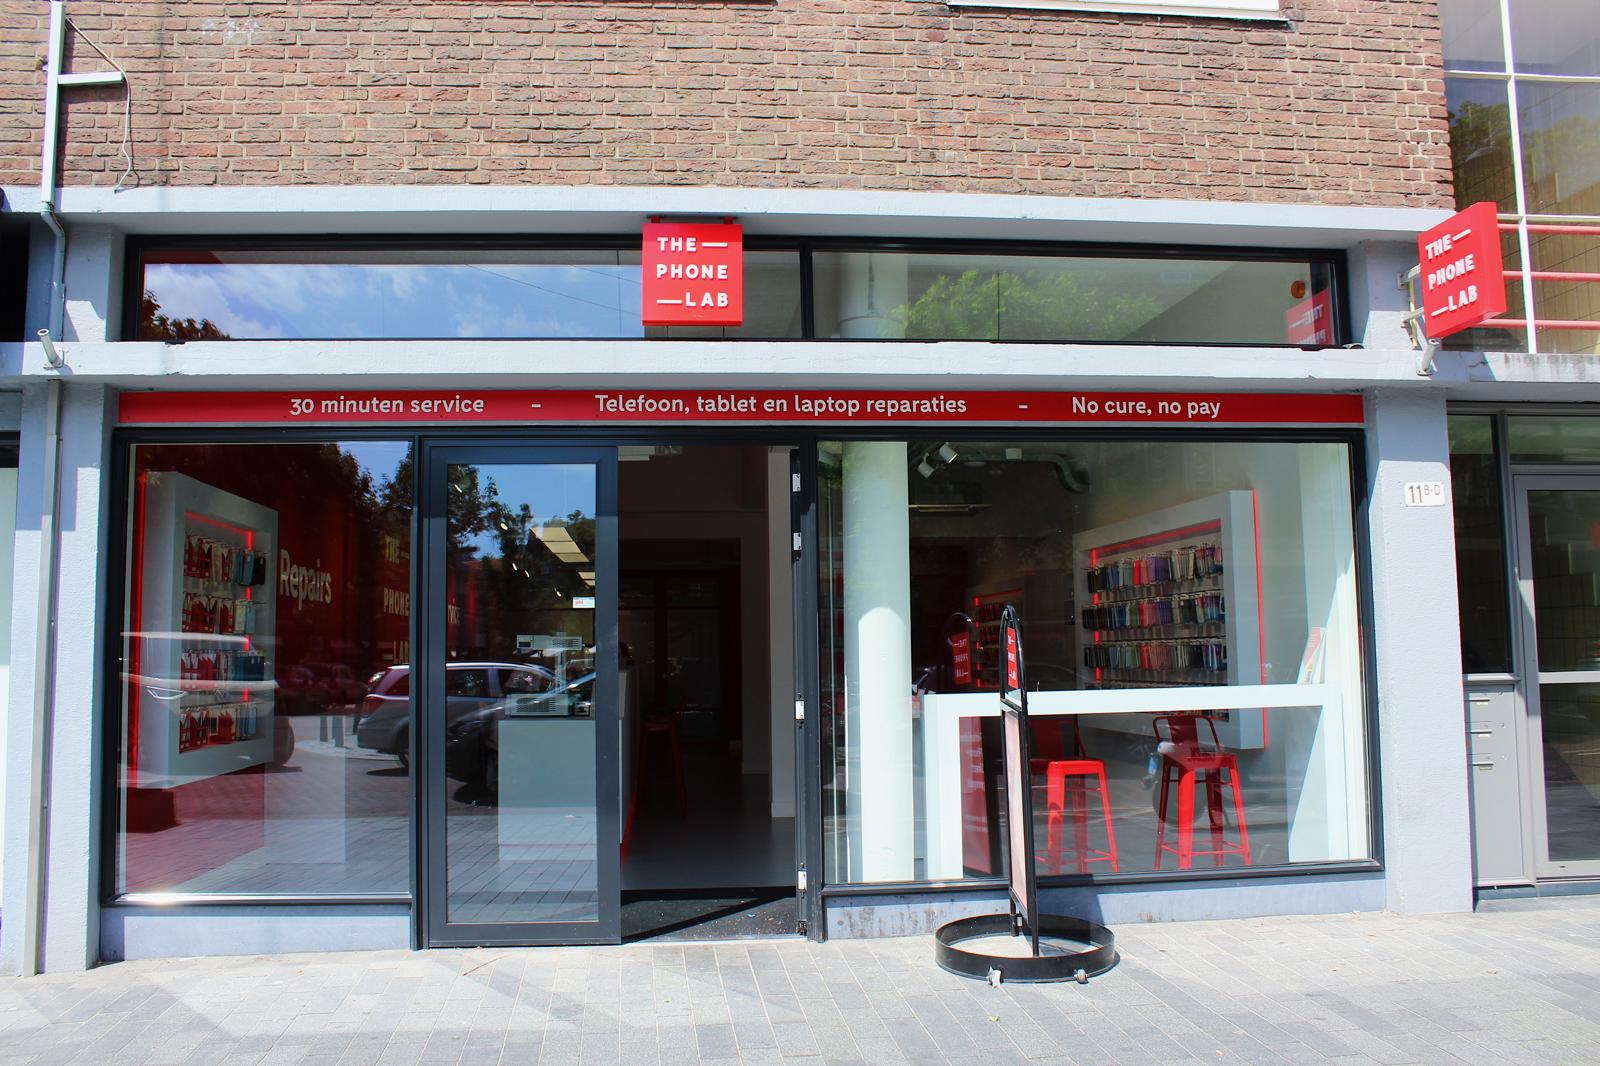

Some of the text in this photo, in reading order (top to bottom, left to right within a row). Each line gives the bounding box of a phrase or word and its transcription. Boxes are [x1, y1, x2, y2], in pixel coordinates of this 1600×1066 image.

[657, 237, 697, 252] THE
[1425, 234, 1452, 259] THE
[656, 264, 728, 279] PHONE
[1428, 254, 1474, 290] PHONE
[685, 292, 728, 307] LAB
[1448, 285, 1477, 311] LAB
[290, 398, 314, 415] 30
[320, 396, 404, 414] minuten
[410, 395, 485, 413] service
[595, 394, 690, 414] Telefoon,
[696, 395, 757, 413] tablet
[763, 400, 788, 413] en
[794, 395, 860, 416] laptop
[866, 396, 967, 416] reparaties
[1072, 397, 1099, 414] No
[1105, 400, 1152, 416] cure,
[1158, 401, 1182, 414] no
[1187, 401, 1220, 418] pay
[280, 549, 331, 610] Repairs
[383, 587, 409, 617] PHONE
